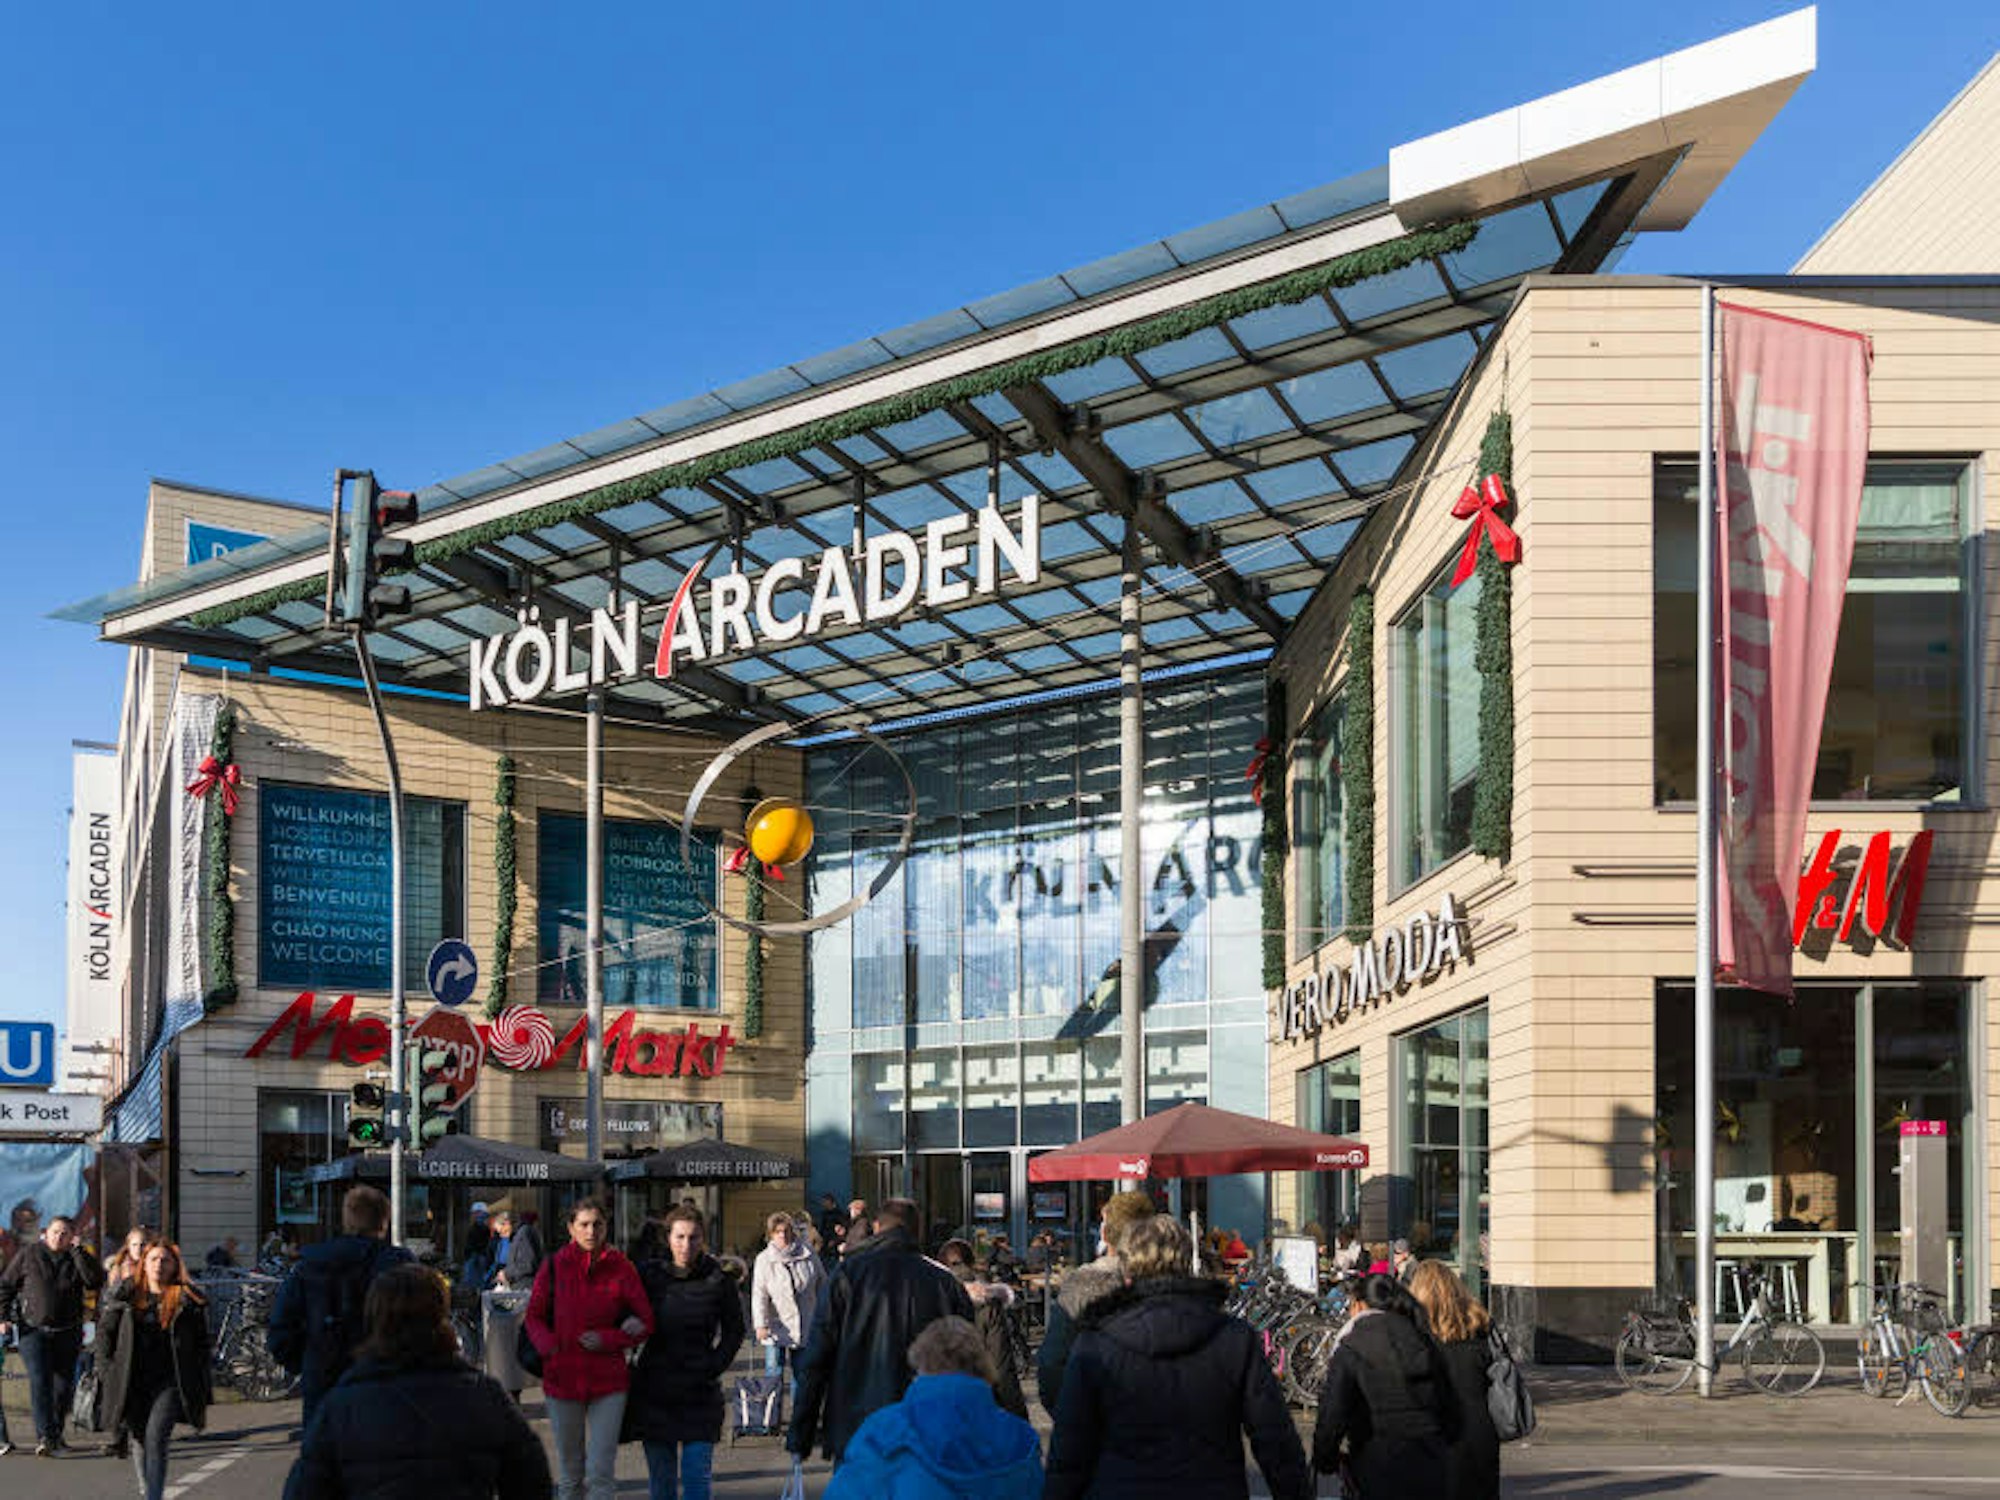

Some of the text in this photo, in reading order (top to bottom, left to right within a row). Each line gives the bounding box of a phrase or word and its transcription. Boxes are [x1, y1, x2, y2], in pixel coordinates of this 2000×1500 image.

[469, 494, 1041, 711] KÖLN ARCADEN
[84, 813, 113, 981] KÖLN ARCADEN
[272, 884, 388, 909] BENVENUTI
[271, 941, 389, 965] WELCOME
[1276, 892, 1461, 1041] VERO MODA
[0, 1030, 41, 1077] U
[545, 1009, 735, 1077] Markt
[25, 1103, 70, 1120] Post
[608, 1119, 650, 1132] FELLOWS
[429, 1160, 548, 1179] COFFEE FELLOWS
[686, 1161, 790, 1177] COFFEE FELLOWS
